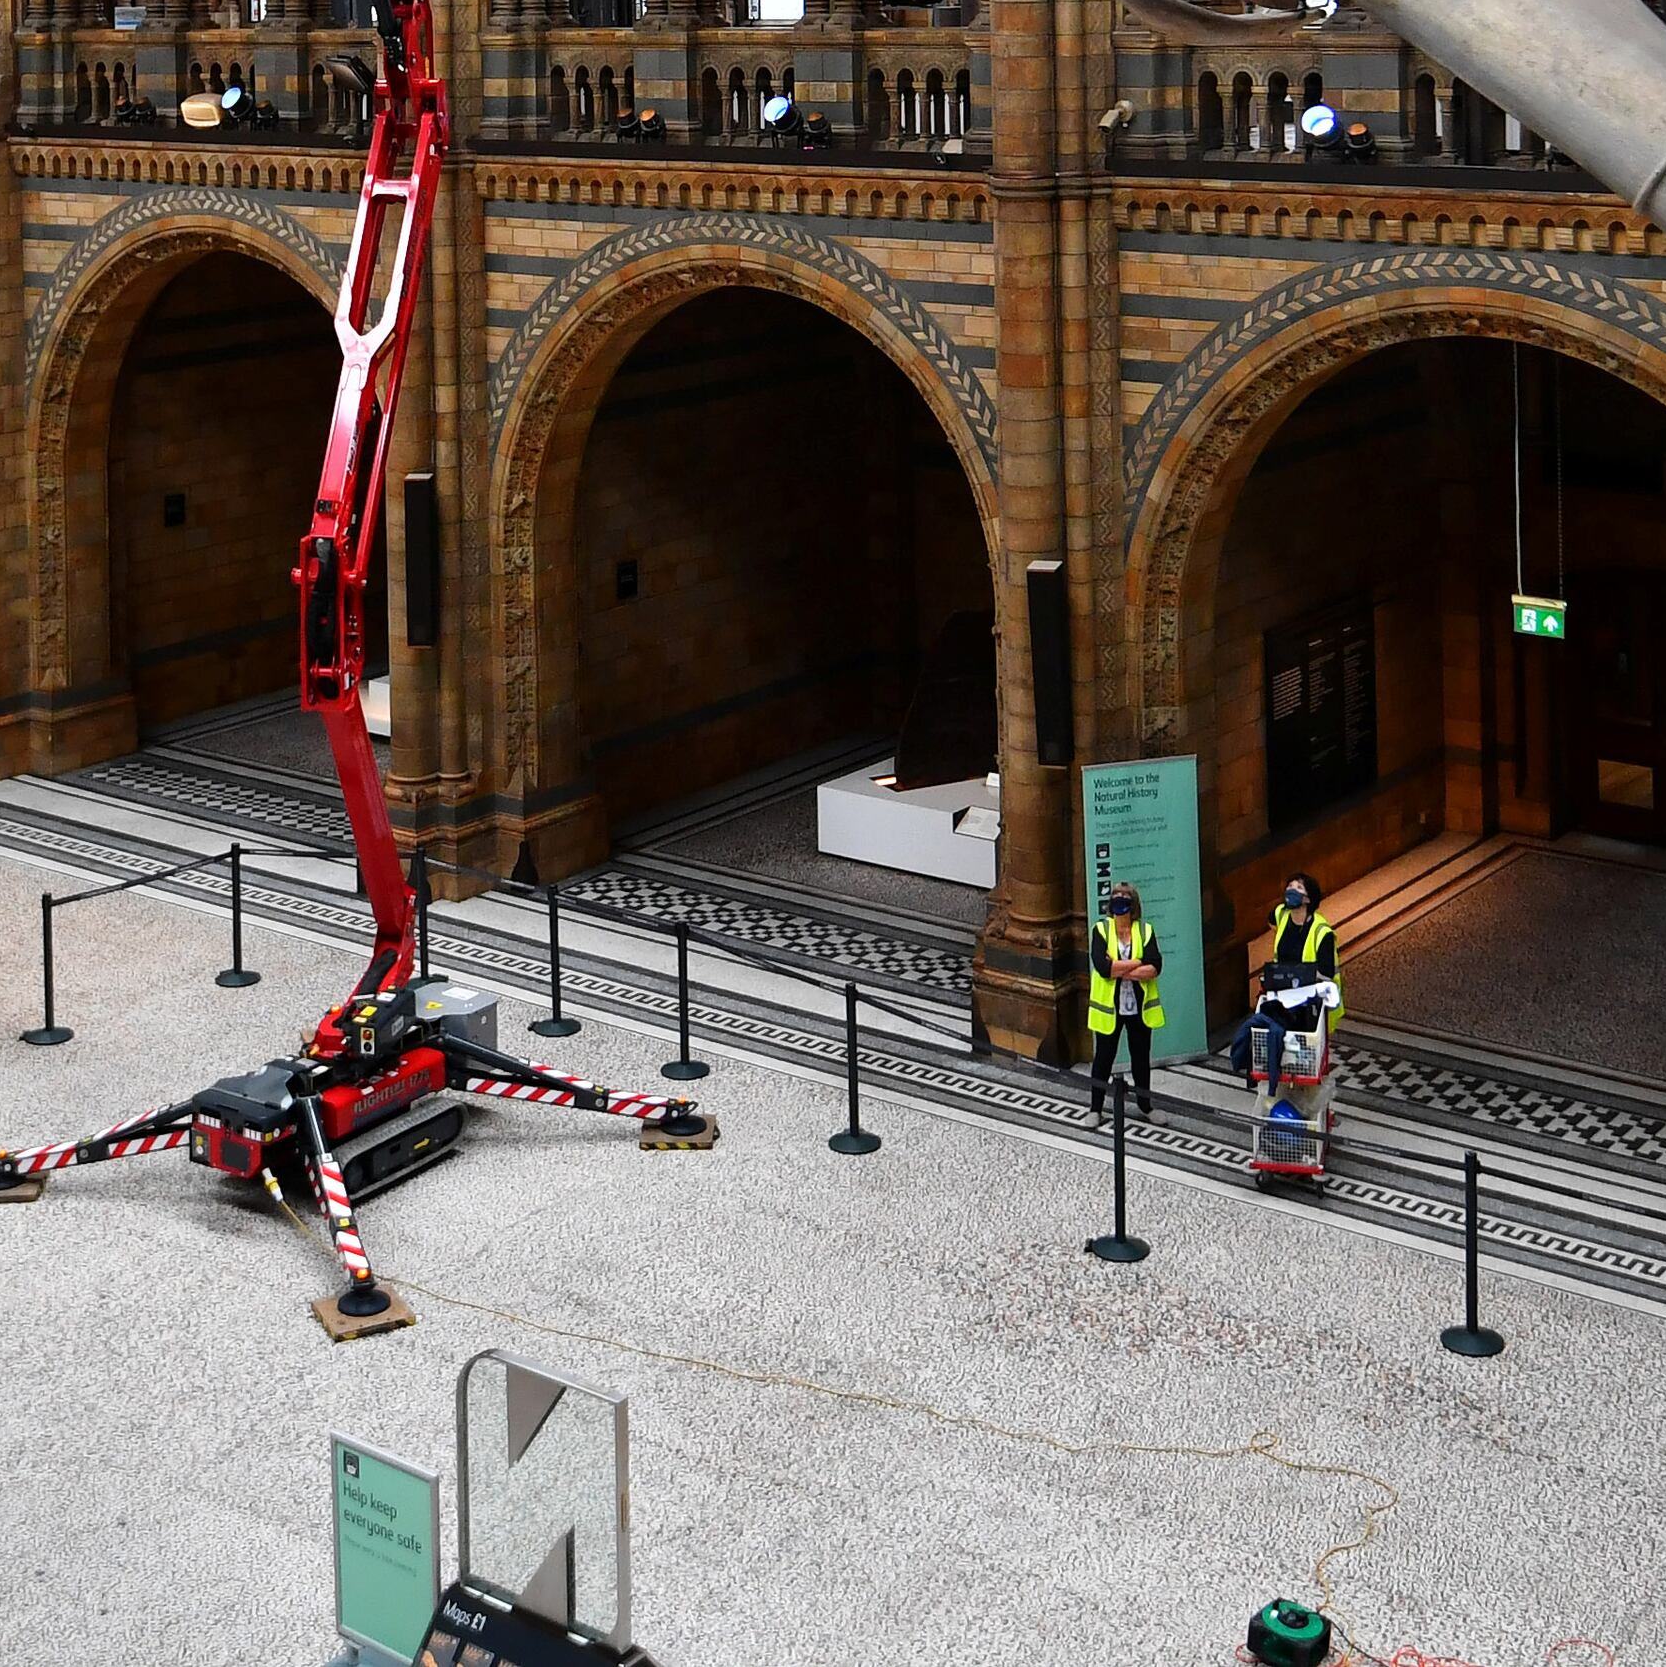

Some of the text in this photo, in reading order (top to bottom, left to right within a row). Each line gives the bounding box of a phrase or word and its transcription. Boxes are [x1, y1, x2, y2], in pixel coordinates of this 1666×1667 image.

[1093, 772, 1160, 789] Welcome to the
[1094, 788, 1158, 802] Natural History
[1094, 805, 1131, 815] Museum
[343, 1480, 397, 1522] Help keep
[343, 1508, 422, 1555] everyone safe
[471, 1612, 487, 1632] £1
